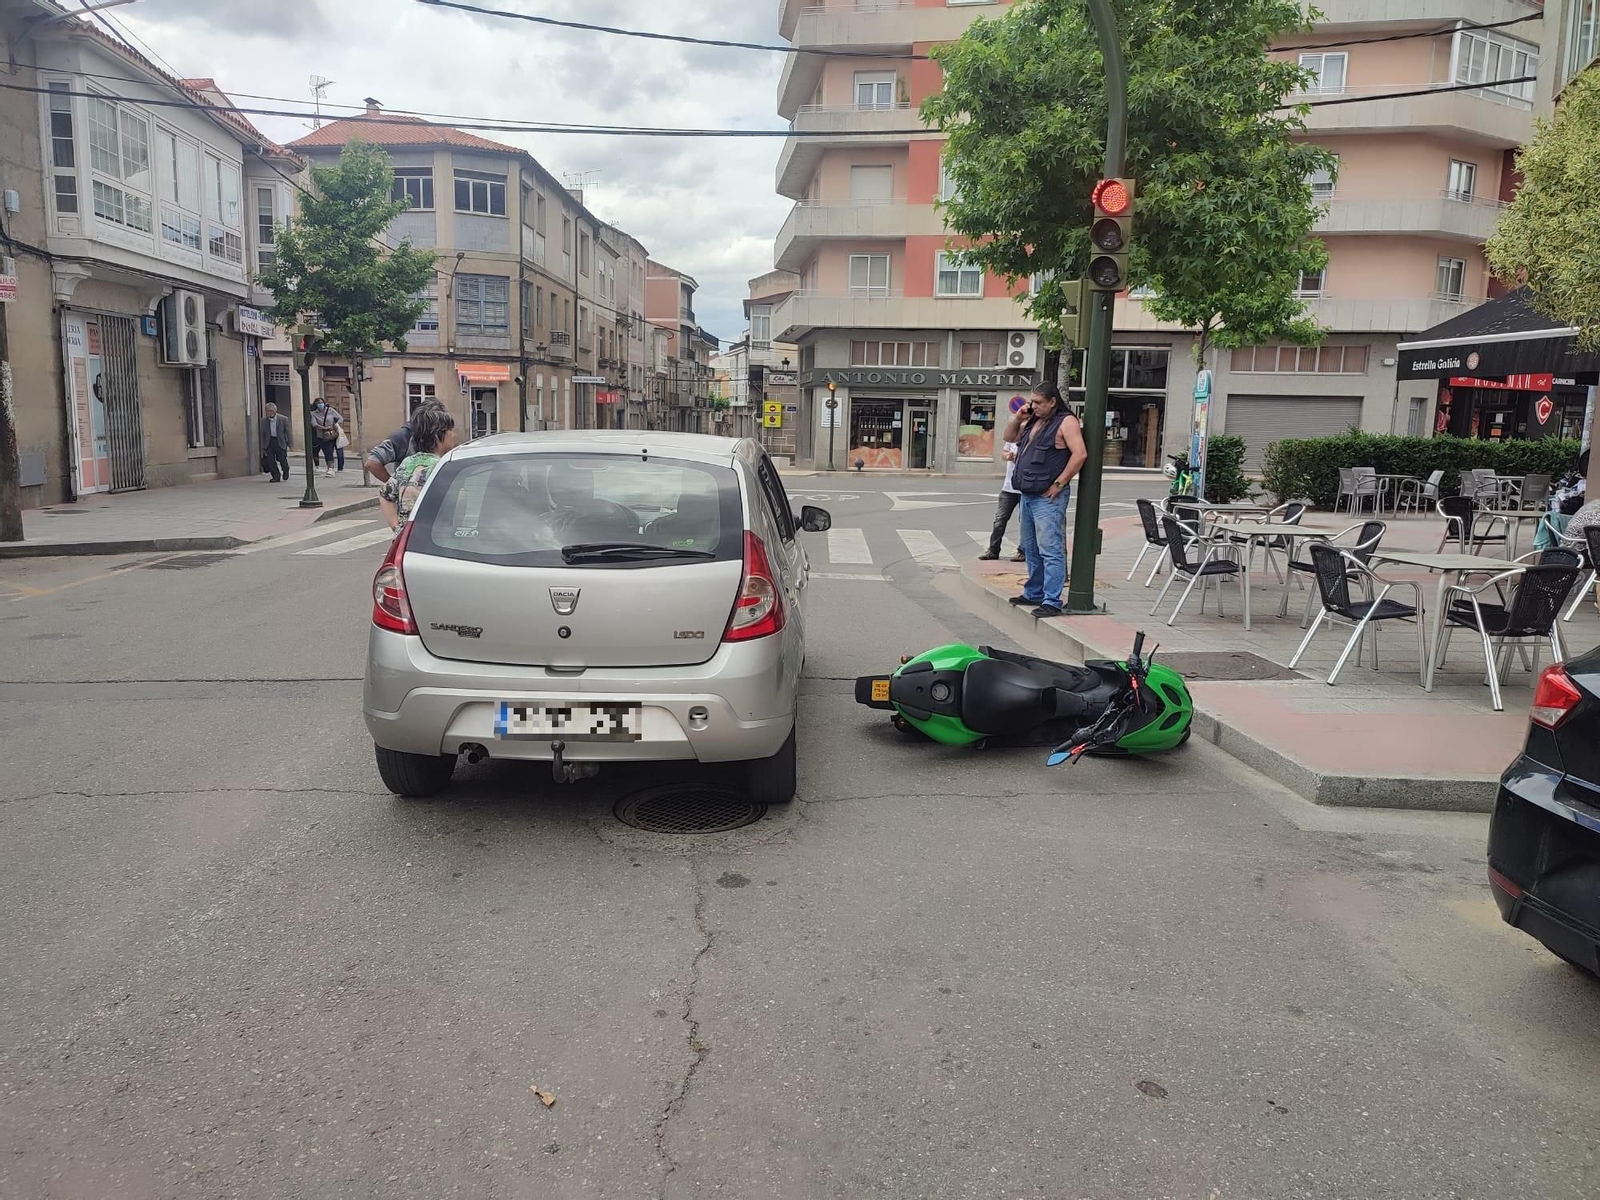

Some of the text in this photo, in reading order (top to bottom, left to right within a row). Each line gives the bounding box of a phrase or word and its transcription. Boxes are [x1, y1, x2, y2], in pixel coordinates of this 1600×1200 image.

[1412, 357, 1461, 371] Estrella Galicia
[821, 371, 926, 384] ANTONIO
[939, 373, 1033, 386] MARTIN
[787, 494, 860, 502] TOP
[430, 622, 483, 634] SANDERO
